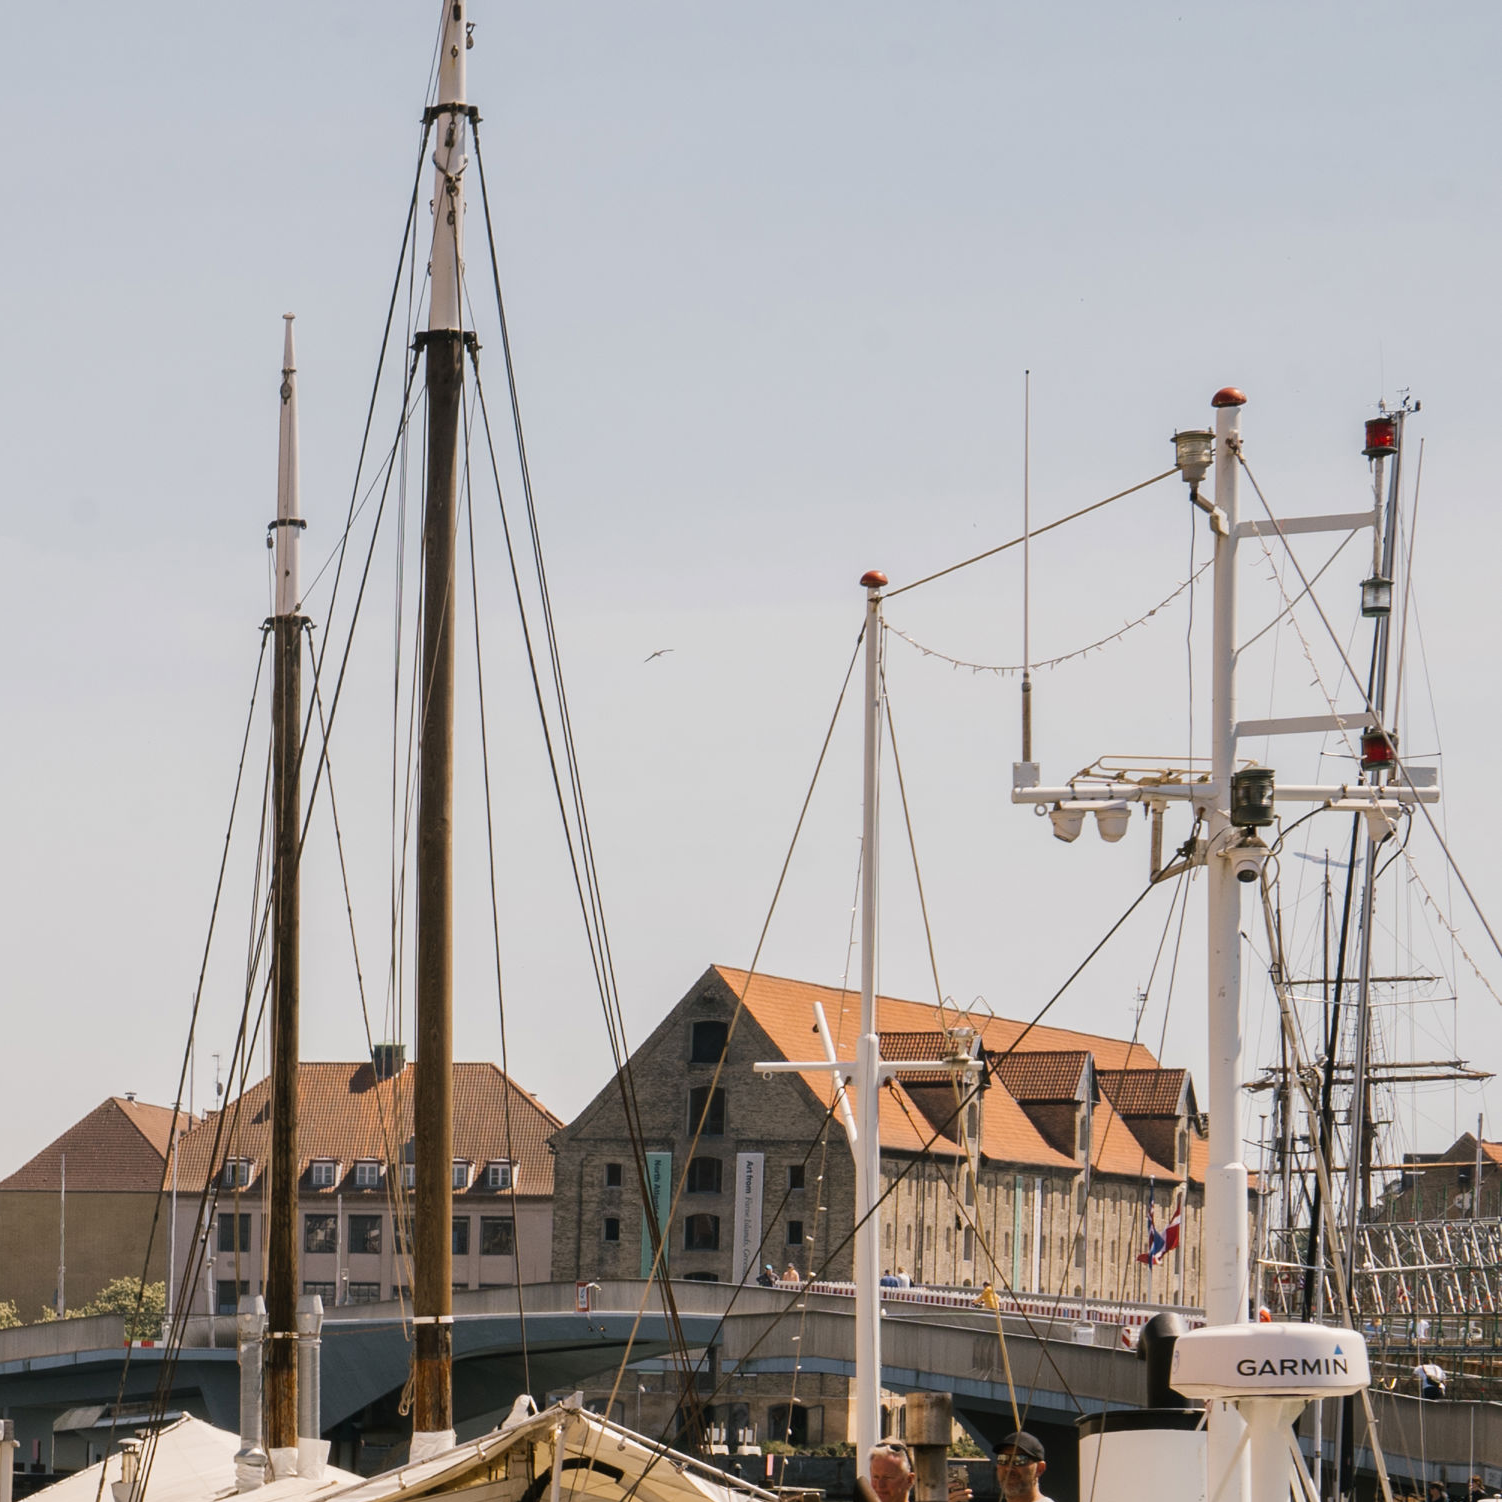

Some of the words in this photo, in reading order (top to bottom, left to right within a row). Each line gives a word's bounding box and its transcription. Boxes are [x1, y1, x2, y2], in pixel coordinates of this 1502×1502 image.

[654, 1160, 662, 1183] North
[746, 1160, 754, 1174] Art
[745, 1175, 753, 1194] from
[1236, 1358, 1349, 1377] GARMIN
